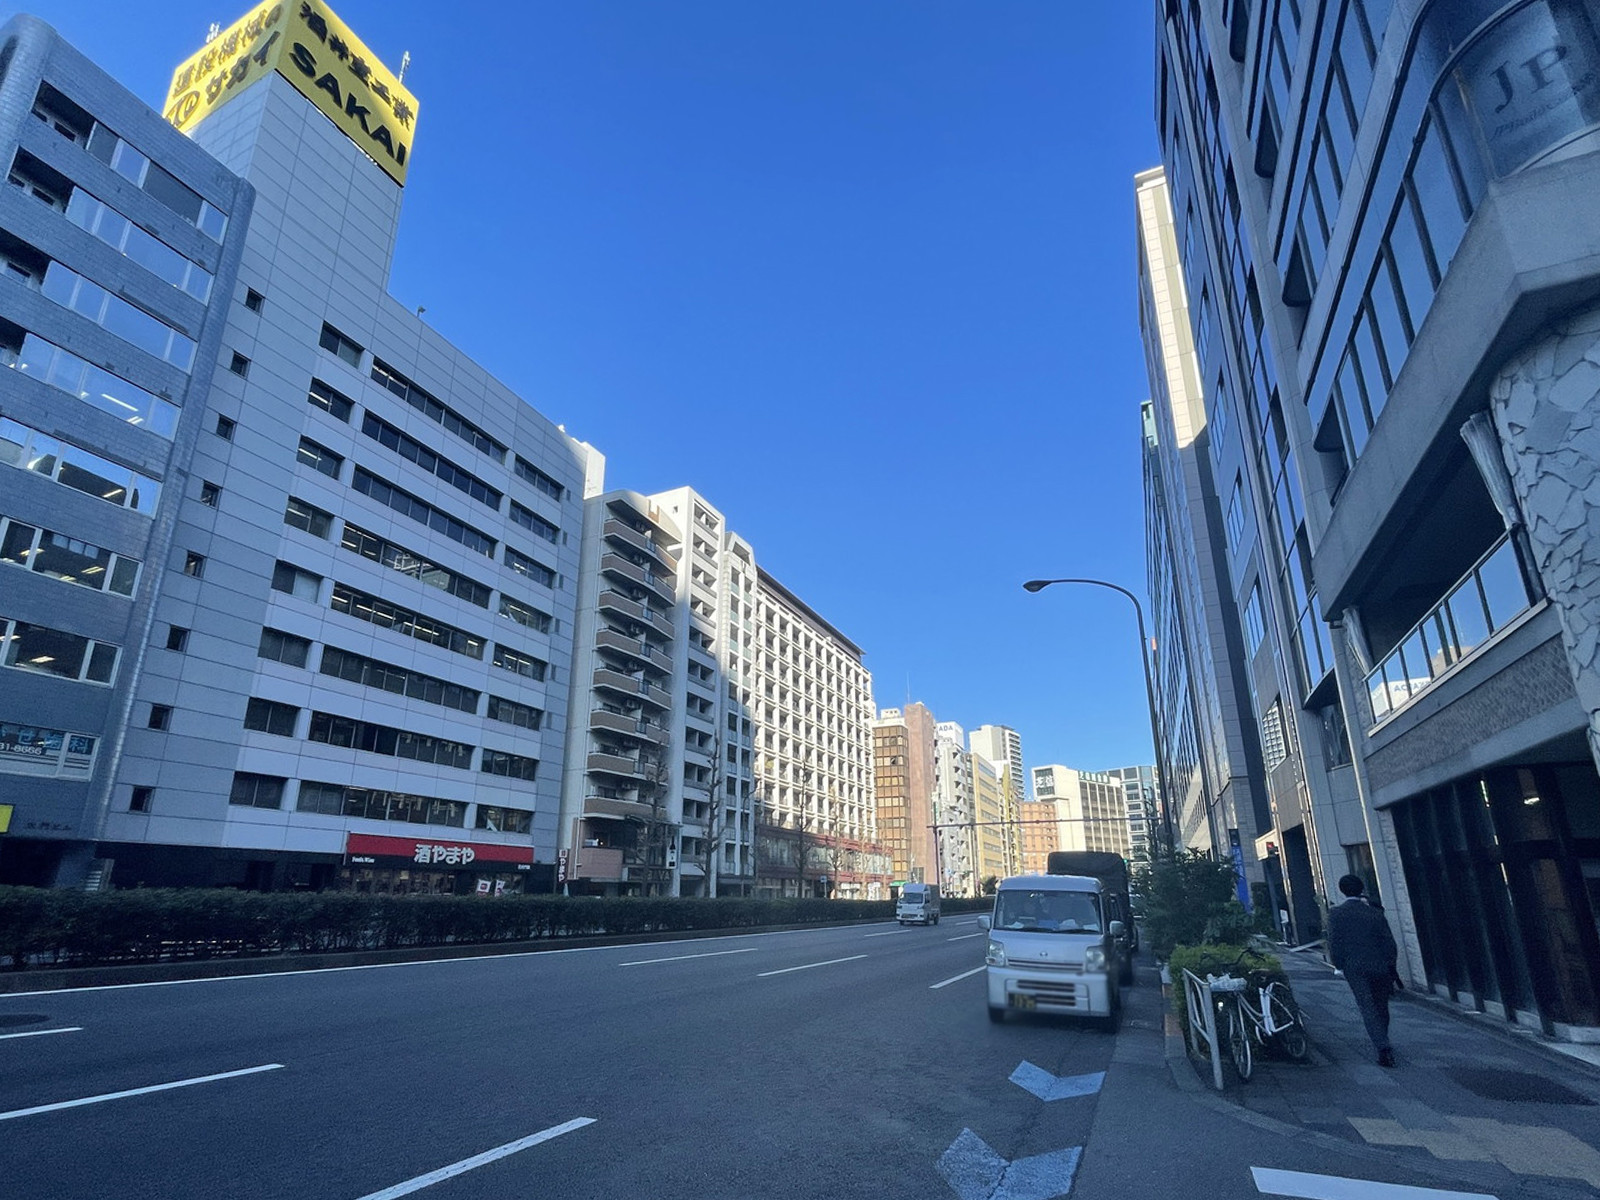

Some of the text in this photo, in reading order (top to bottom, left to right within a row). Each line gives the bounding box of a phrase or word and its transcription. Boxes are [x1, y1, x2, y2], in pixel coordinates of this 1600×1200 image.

[289, 42, 407, 167] SAKAI
[414, 843, 475, 865] 酒やまや
